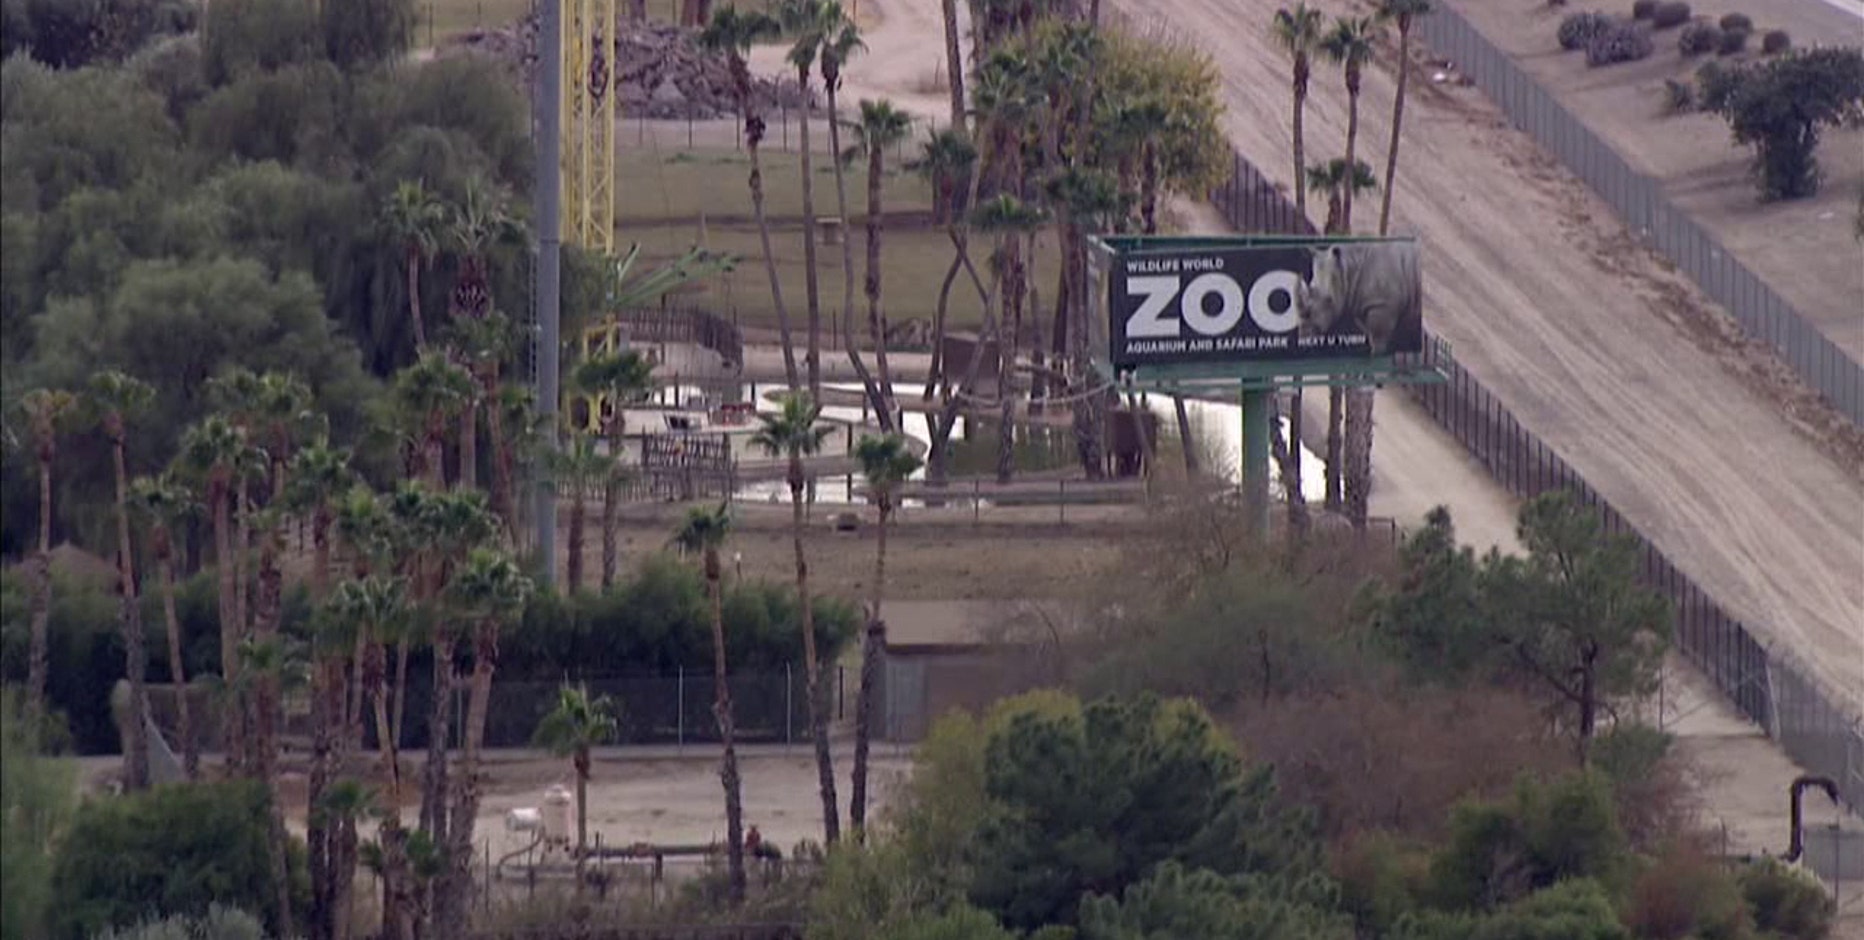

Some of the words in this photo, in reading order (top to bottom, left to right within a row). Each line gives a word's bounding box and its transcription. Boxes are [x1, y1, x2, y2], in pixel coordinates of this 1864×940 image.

[1127, 258, 1179, 272] WILDLIFE
[1183, 257, 1224, 271] WORLD
[1126, 269, 1302, 338] ZOO
[1126, 339, 1186, 355] AQUARIUM
[1190, 339, 1213, 351] AND
[1215, 338, 1256, 351] SAFARI
[1258, 337, 1288, 349] PARK
[1298, 337, 1325, 347] NEXT
[1337, 335, 1366, 346] TURN
